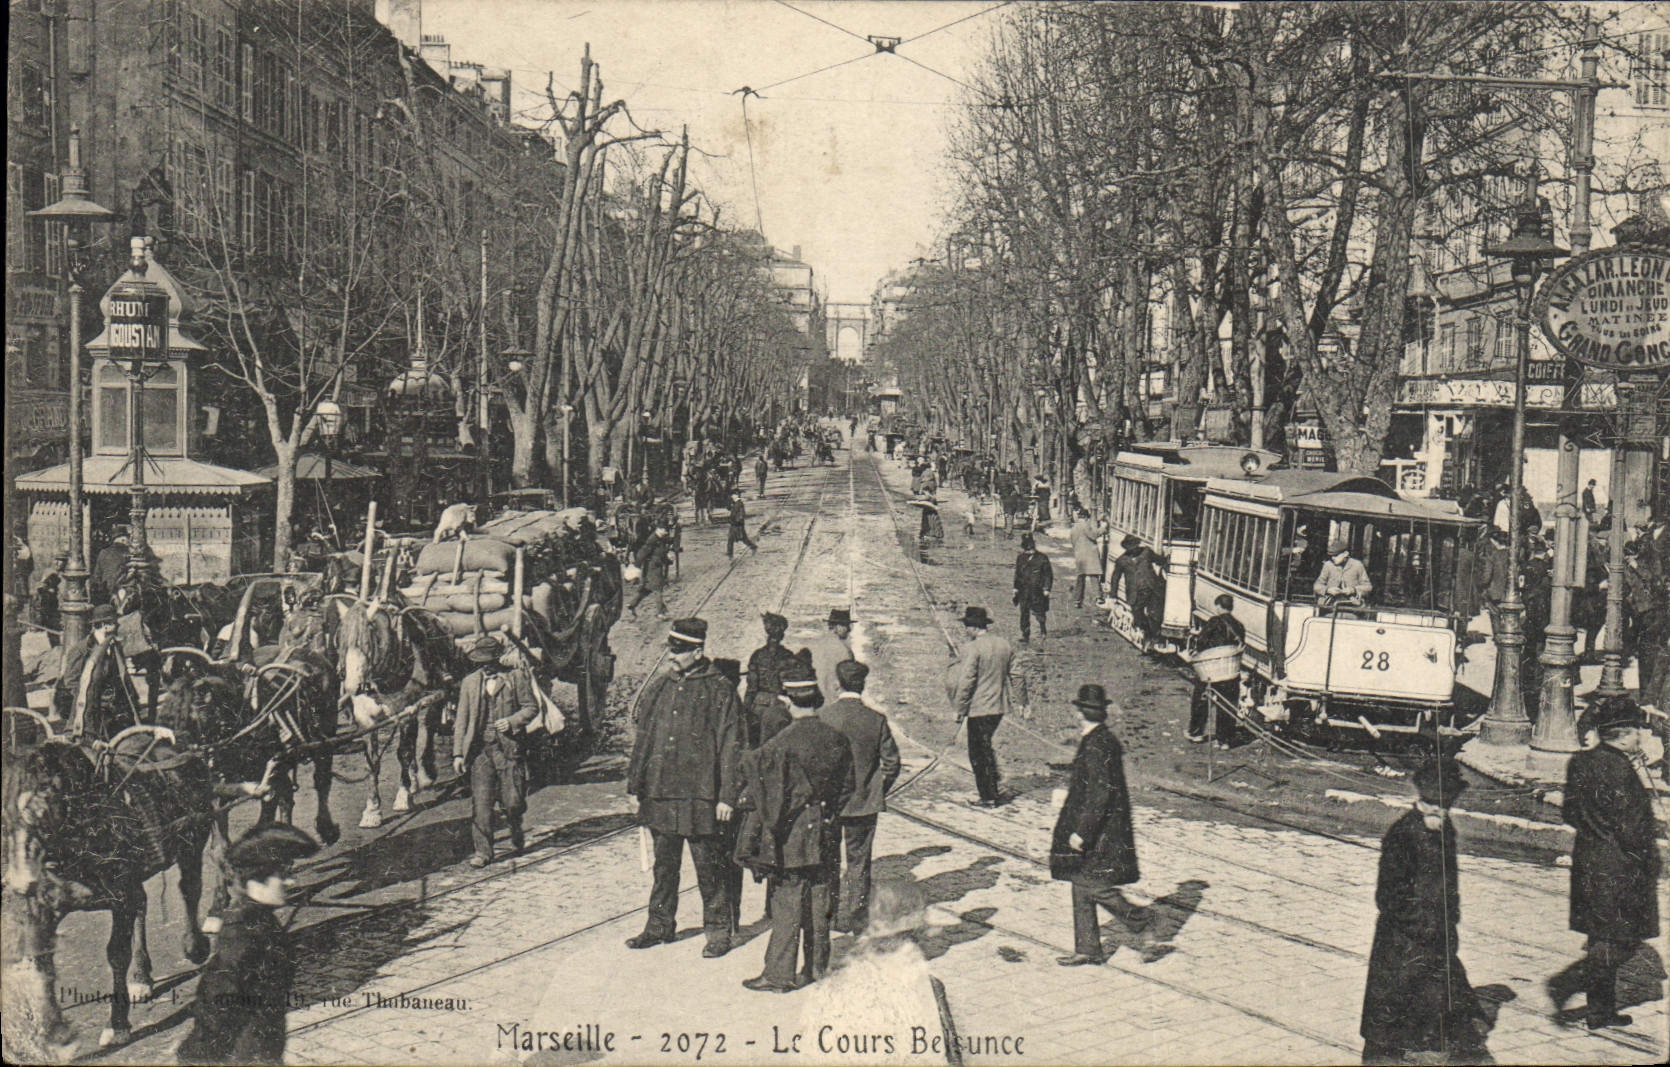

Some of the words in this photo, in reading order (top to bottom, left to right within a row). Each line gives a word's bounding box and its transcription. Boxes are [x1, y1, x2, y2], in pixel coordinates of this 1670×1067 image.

[1620, 256, 1664, 279] LEON
[1587, 280, 1665, 299] DIMANCHE
[110, 301, 150, 317] RHUM
[1581, 300, 1624, 314] LUNDI
[1559, 320, 1612, 361] GRAND
[1361, 650, 1390, 671] 28
